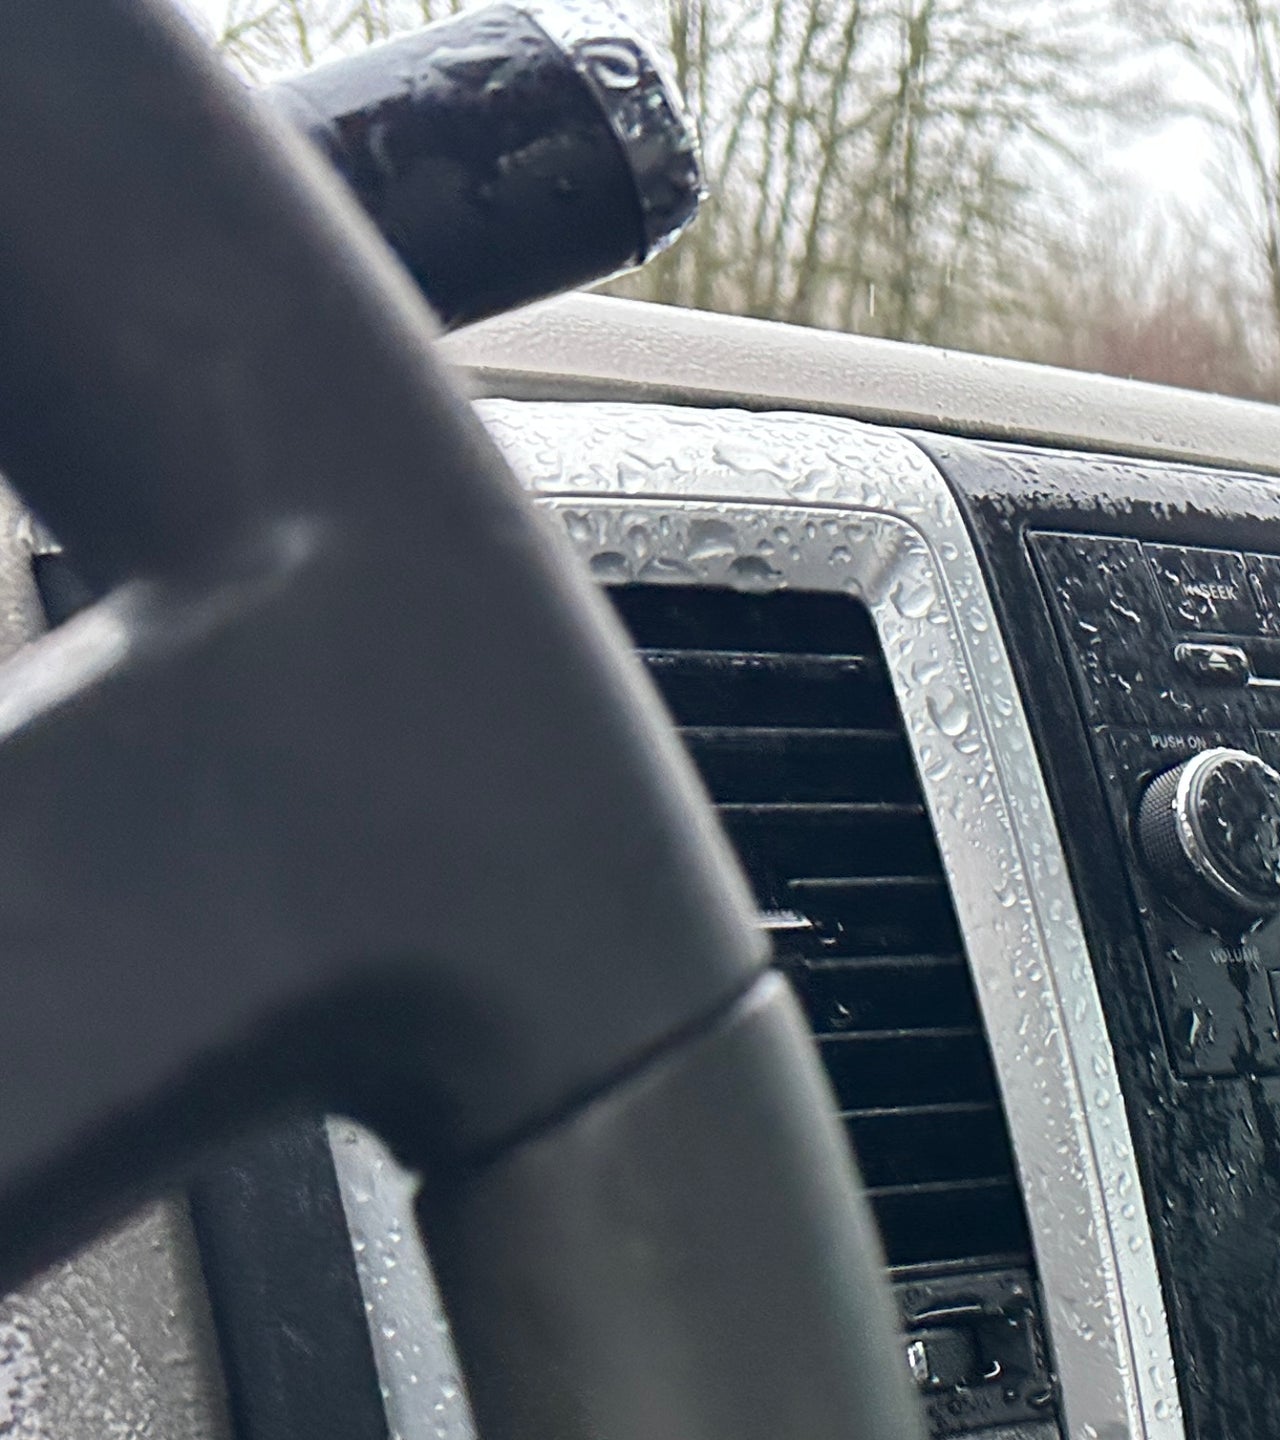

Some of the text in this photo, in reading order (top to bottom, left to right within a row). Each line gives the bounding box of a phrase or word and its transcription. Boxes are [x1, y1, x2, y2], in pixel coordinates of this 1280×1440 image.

[1199, 583, 1238, 601] SEEK
[1151, 734, 1206, 749] PUSH ON
